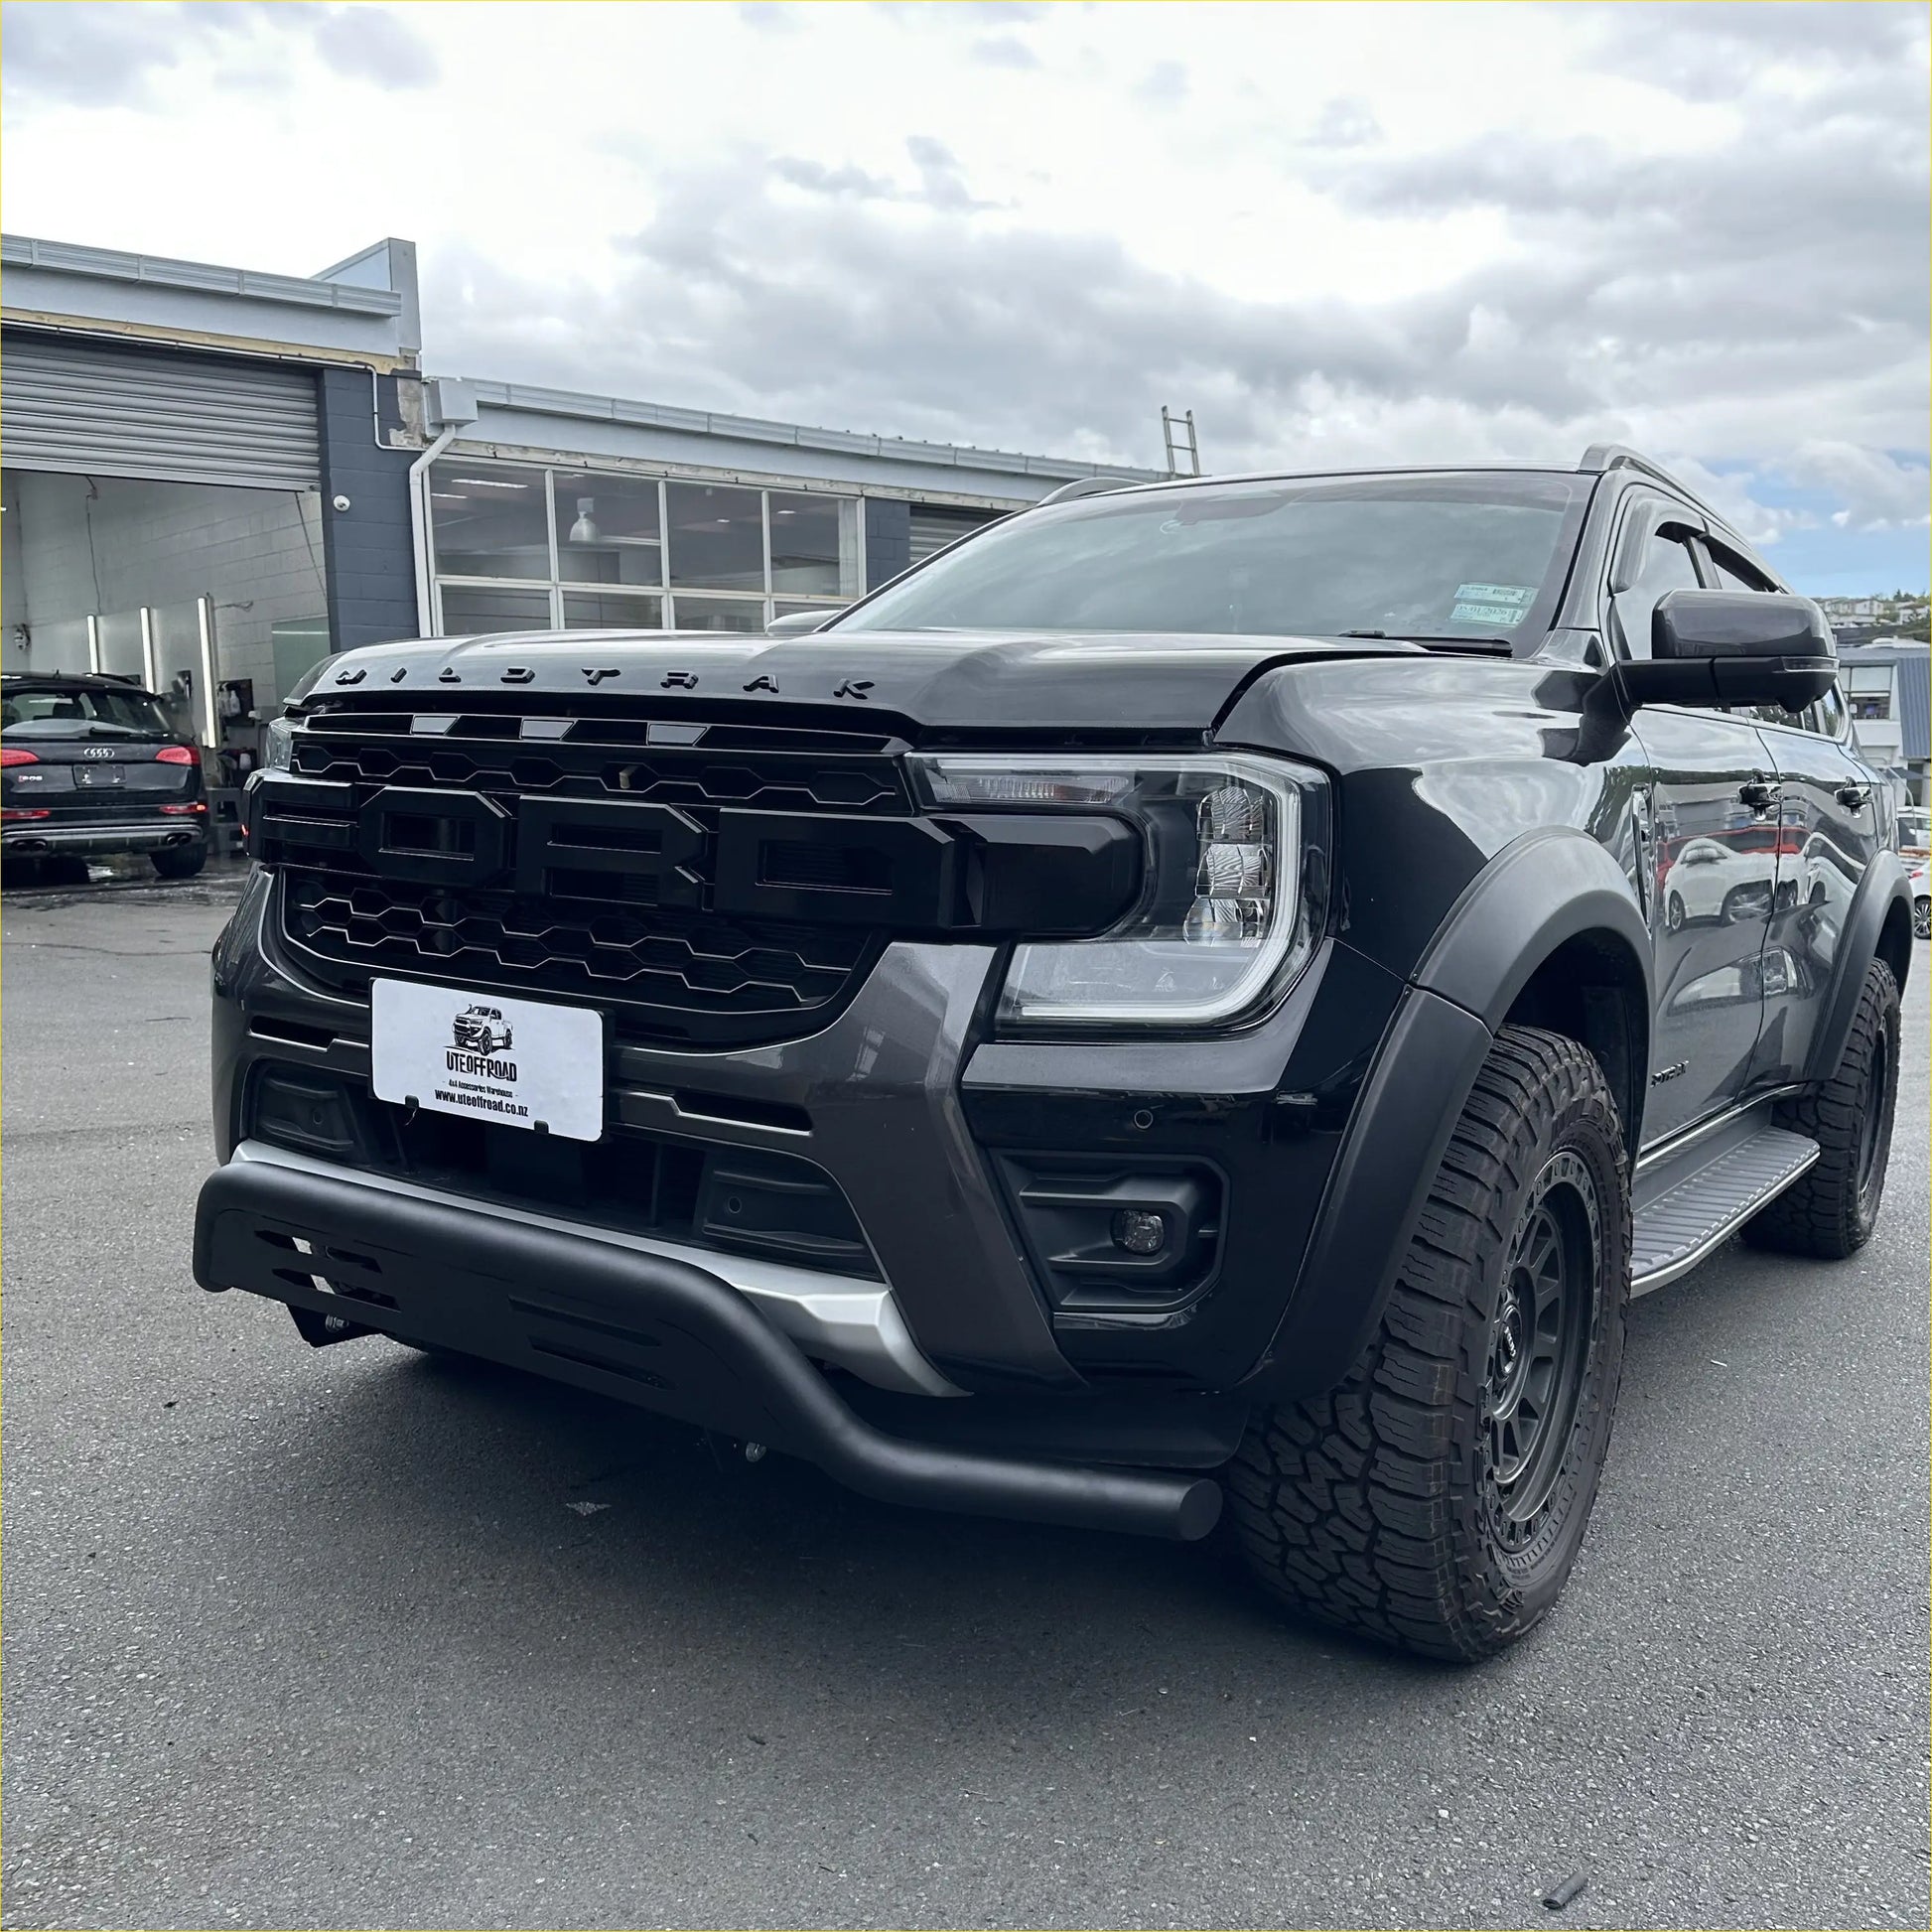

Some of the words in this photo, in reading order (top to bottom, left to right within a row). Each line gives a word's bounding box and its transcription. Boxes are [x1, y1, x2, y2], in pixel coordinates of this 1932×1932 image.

[335, 665, 875, 700] WILDTRAK
[245, 773, 955, 925] FORD
[447, 1050, 517, 1082] UTEOFFROAD
[435, 1089, 528, 1117] www.uteoffroad.co.nz
[458, 1080, 486, 1093] Accessories
[486, 1085, 513, 1098] Warehouse
